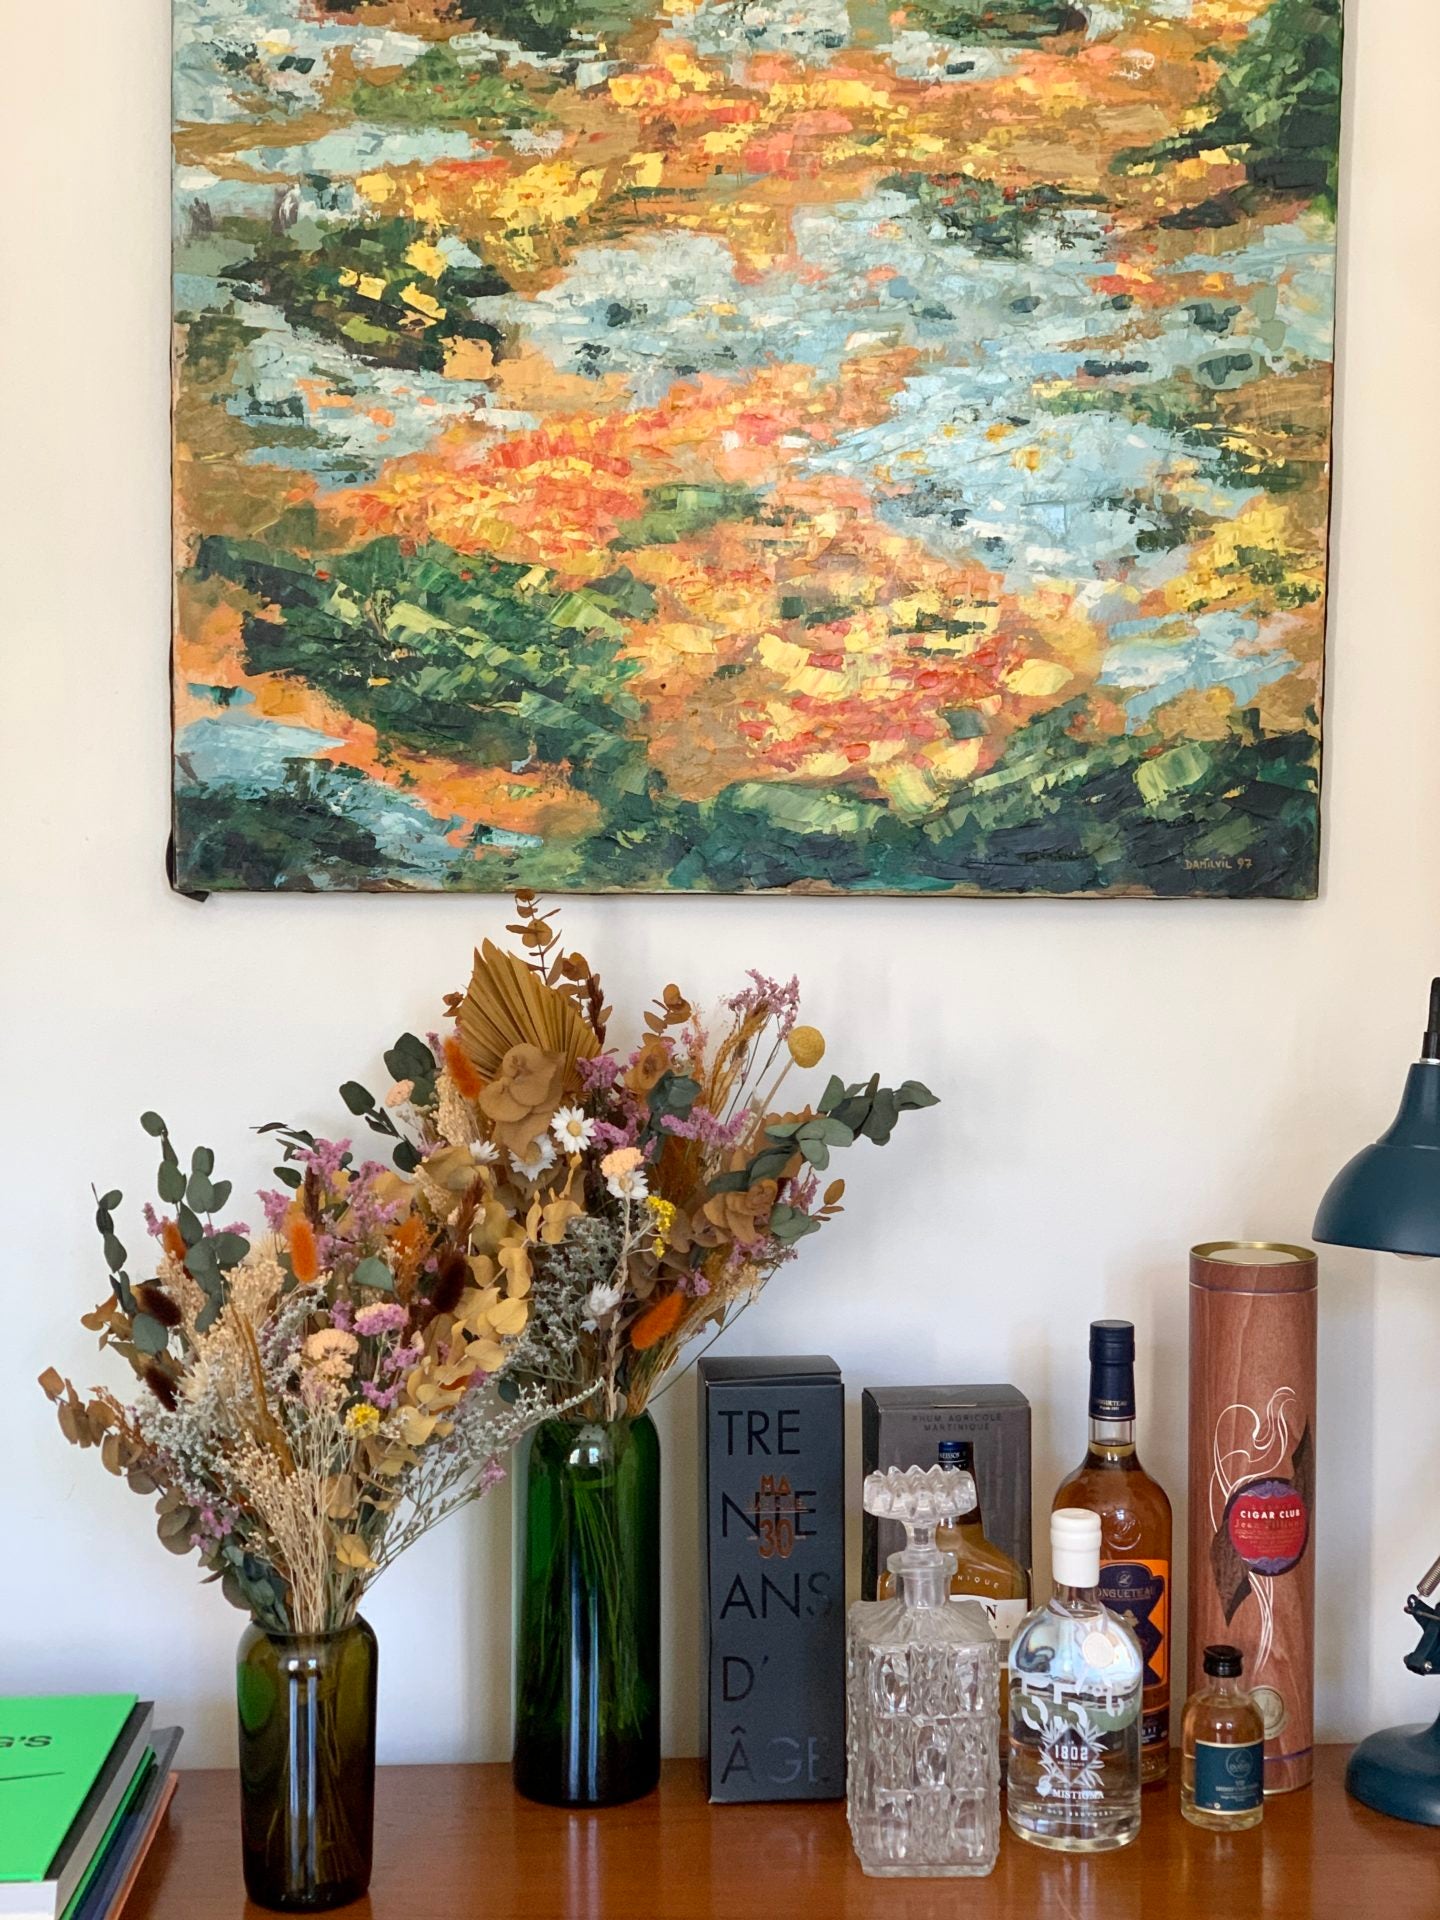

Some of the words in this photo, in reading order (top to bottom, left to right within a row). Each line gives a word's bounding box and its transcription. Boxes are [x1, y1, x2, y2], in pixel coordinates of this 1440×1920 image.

[1236, 857, 1253, 870] 97
[923, 1423, 990, 1432] MARTINIQUE
[948, 1413, 1002, 1422] AGRICOLE
[717, 1409, 801, 1456] TRE
[1240, 1510, 1275, 1520] CIGAR
[1279, 1508, 1300, 1519] CLUB
[758, 1518, 795, 1559] 30
[719, 1571, 832, 1620] ANS
[721, 1655, 770, 1703] D'
[719, 1724, 831, 1785] ÂGE
[1054, 1744, 1089, 1761] 1802
